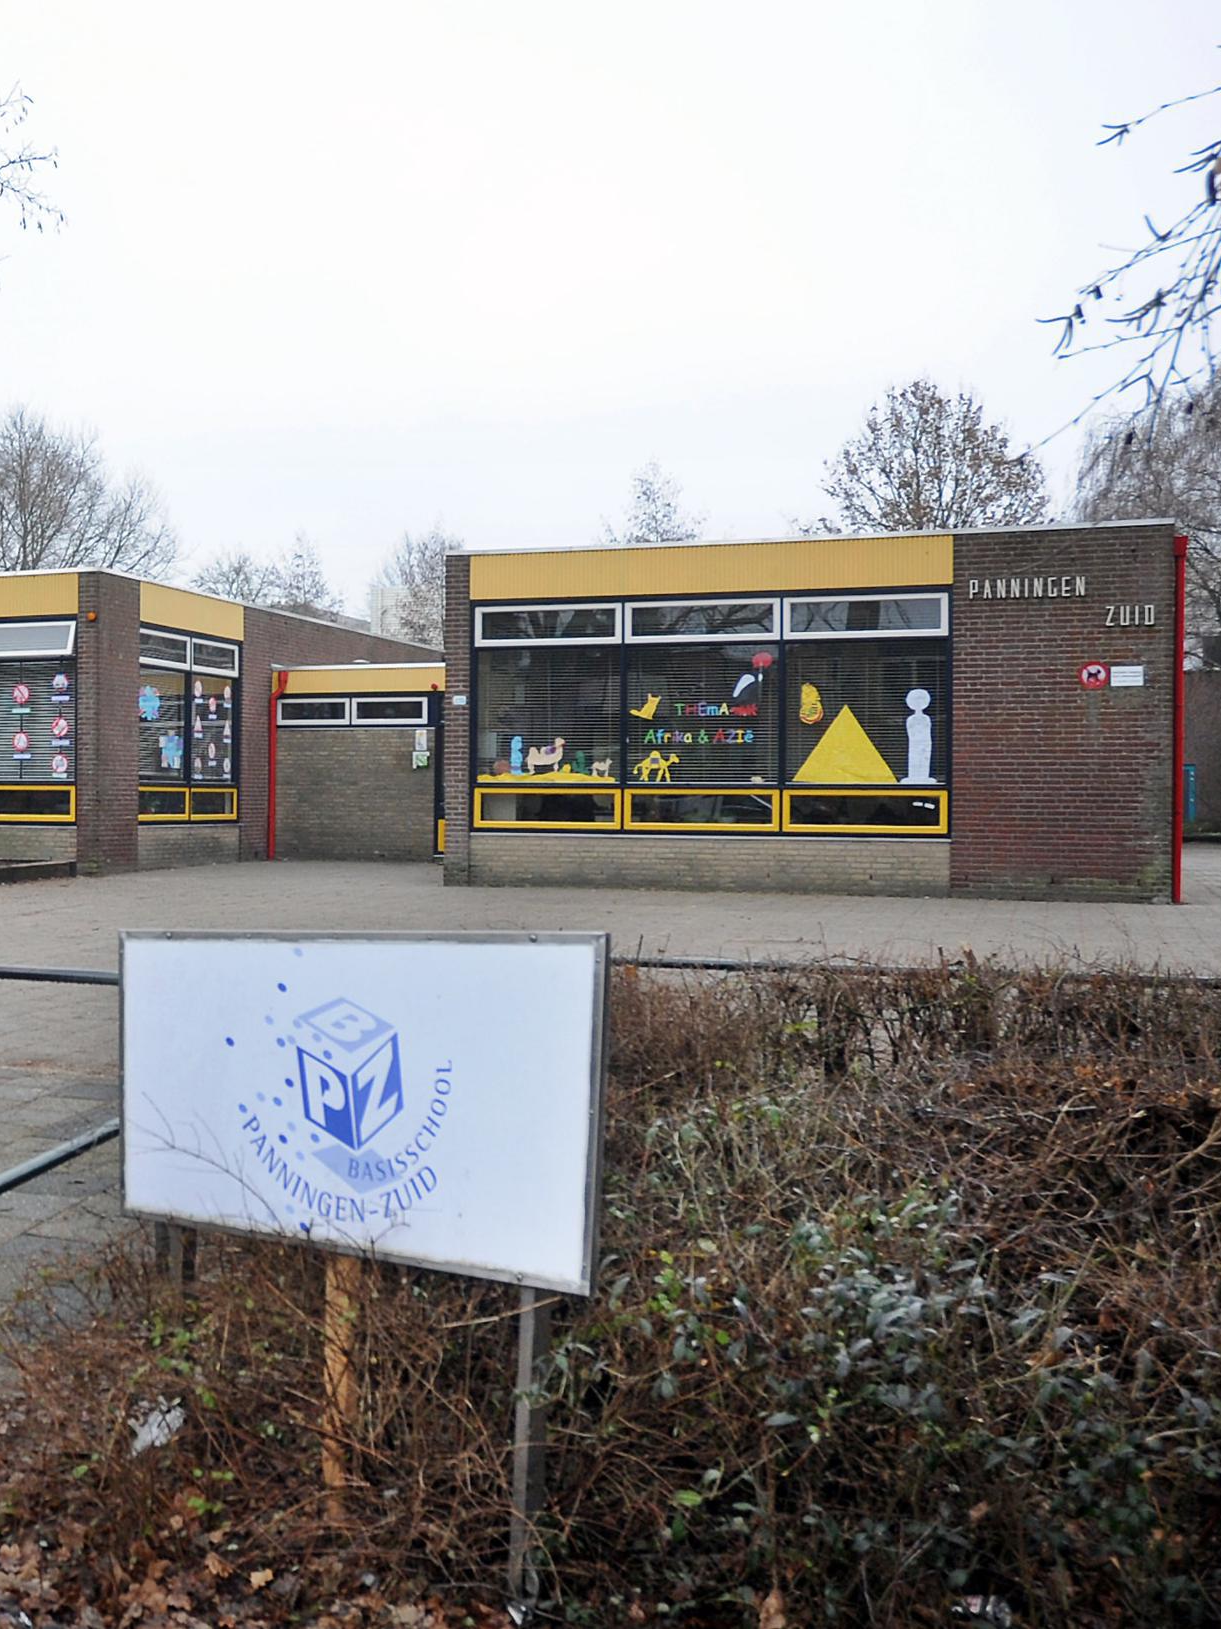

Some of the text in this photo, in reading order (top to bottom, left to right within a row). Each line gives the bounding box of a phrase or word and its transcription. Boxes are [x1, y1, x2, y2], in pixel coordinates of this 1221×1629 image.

[968, 576, 1086, 600] PANNINGEN
[1105, 604, 1156, 627] ZUID
[698, 729, 710, 744] &
[347, 1059, 453, 1182] BASISSCHOOL
[242, 1113, 438, 1224] PANNINGEN-ZUID
